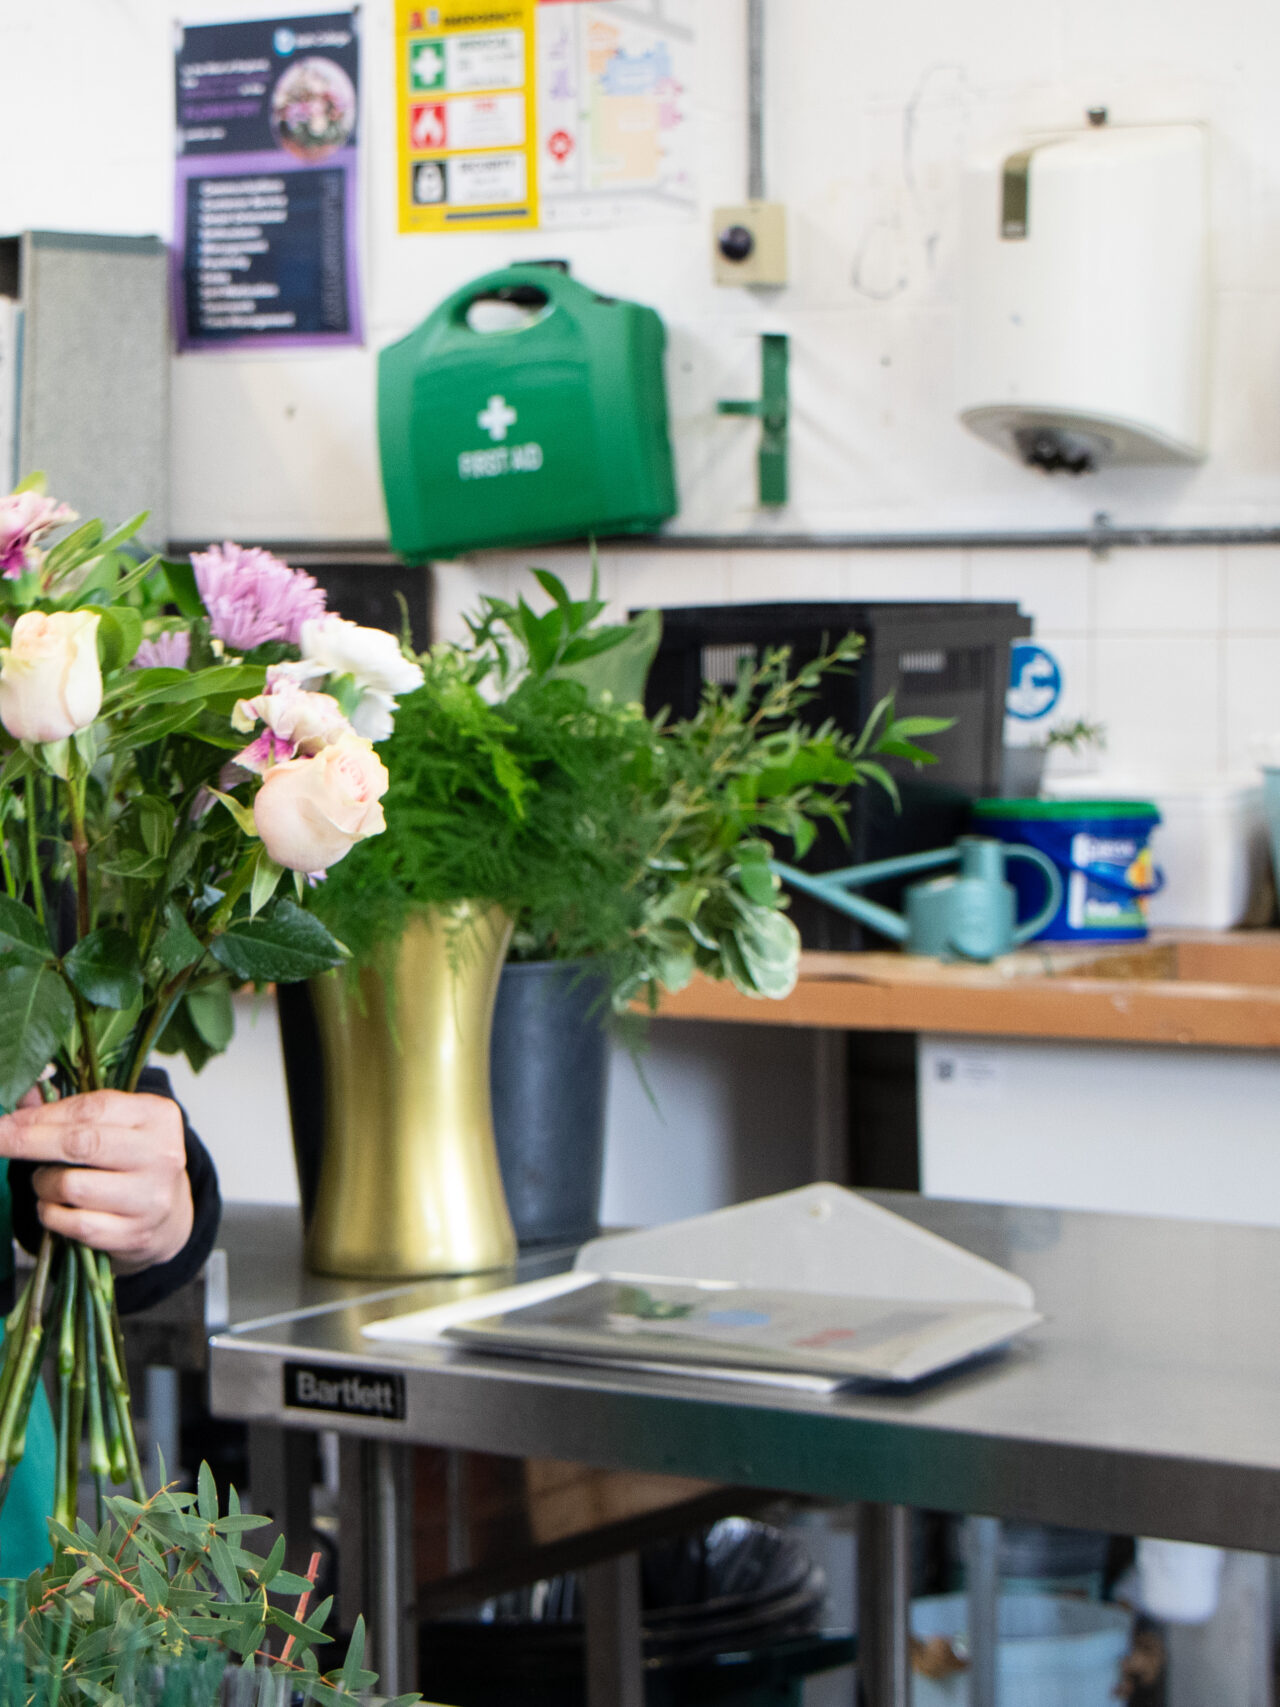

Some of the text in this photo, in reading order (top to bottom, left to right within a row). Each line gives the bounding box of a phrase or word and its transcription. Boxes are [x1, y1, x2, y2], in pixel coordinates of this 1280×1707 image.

[458, 443, 543, 481] FIRST AID
[297, 1370, 393, 1413] Bartlett
